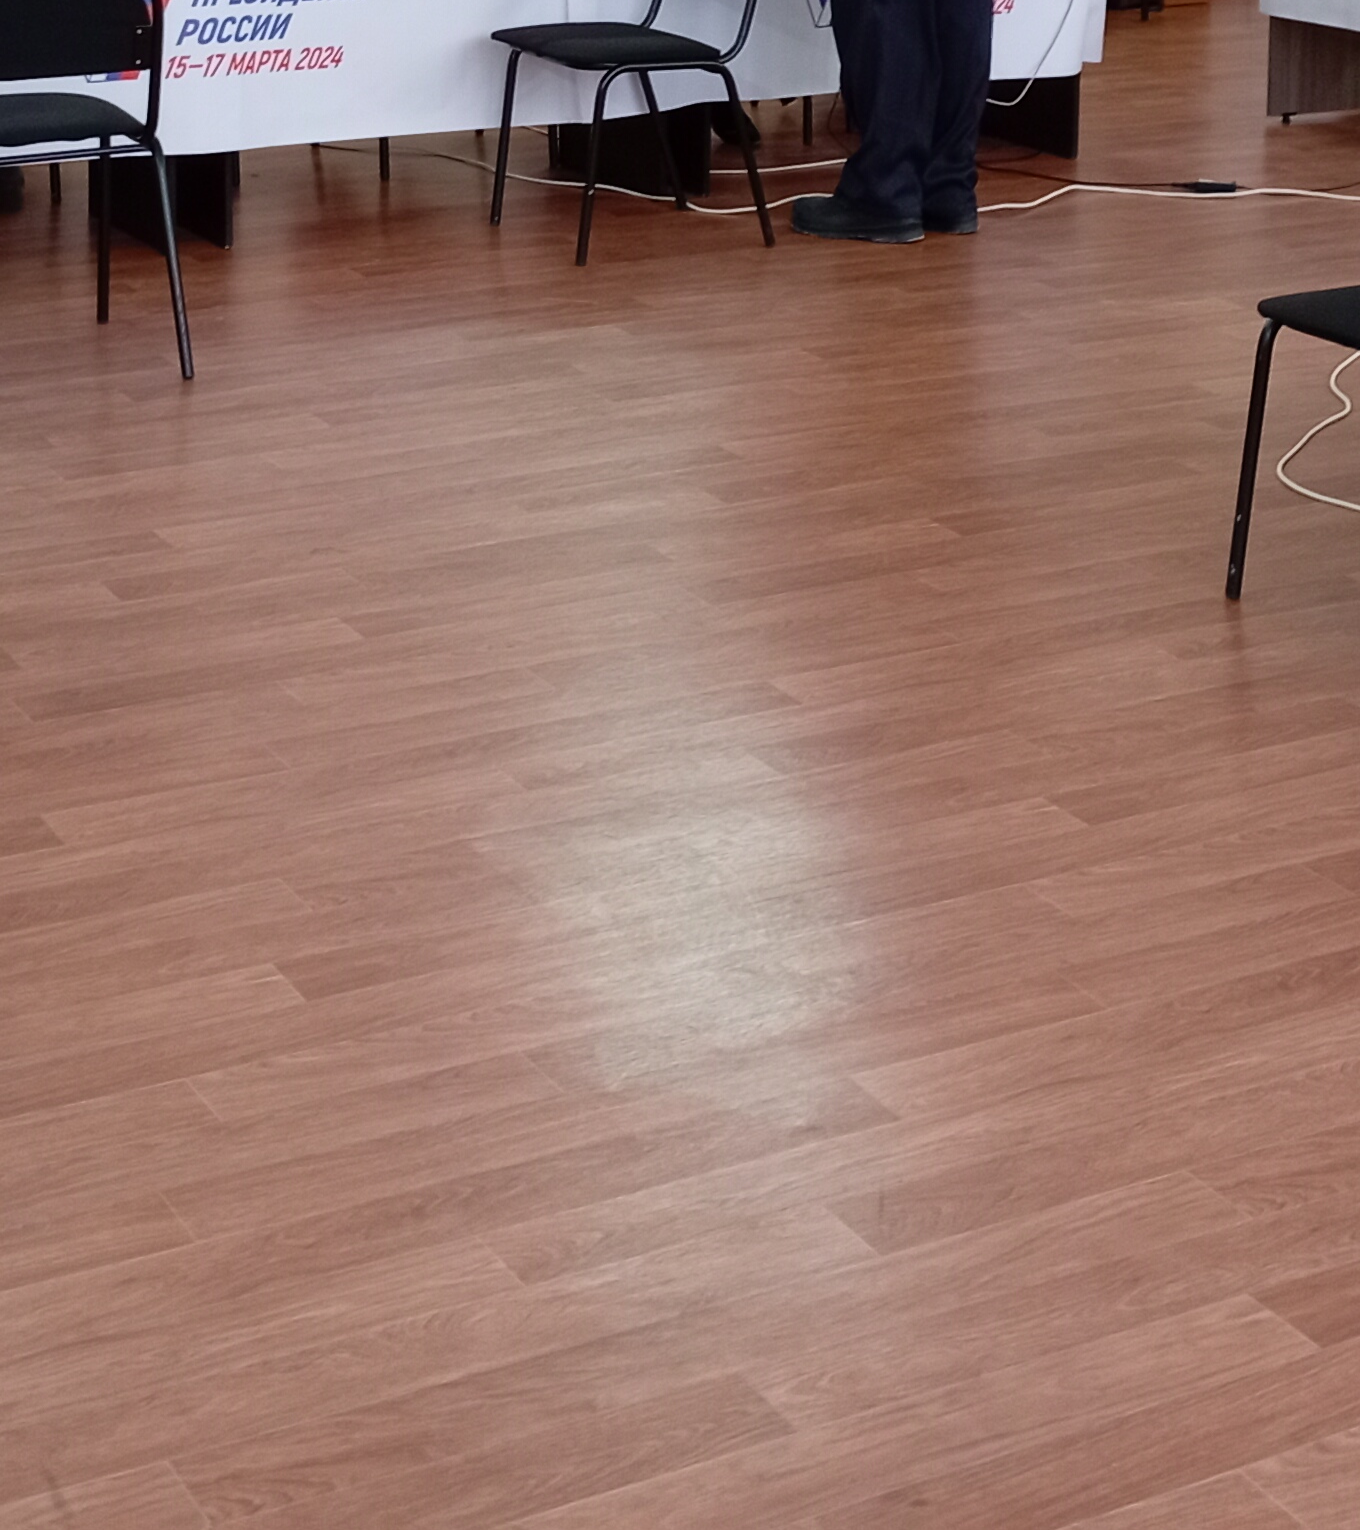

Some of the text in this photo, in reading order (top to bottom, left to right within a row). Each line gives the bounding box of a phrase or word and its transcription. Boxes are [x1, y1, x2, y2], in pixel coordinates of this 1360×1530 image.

[175, 12, 294, 47] РОССИИ
[225, 47, 292, 77] МАРТА
[294, 45, 344, 71] 2024
